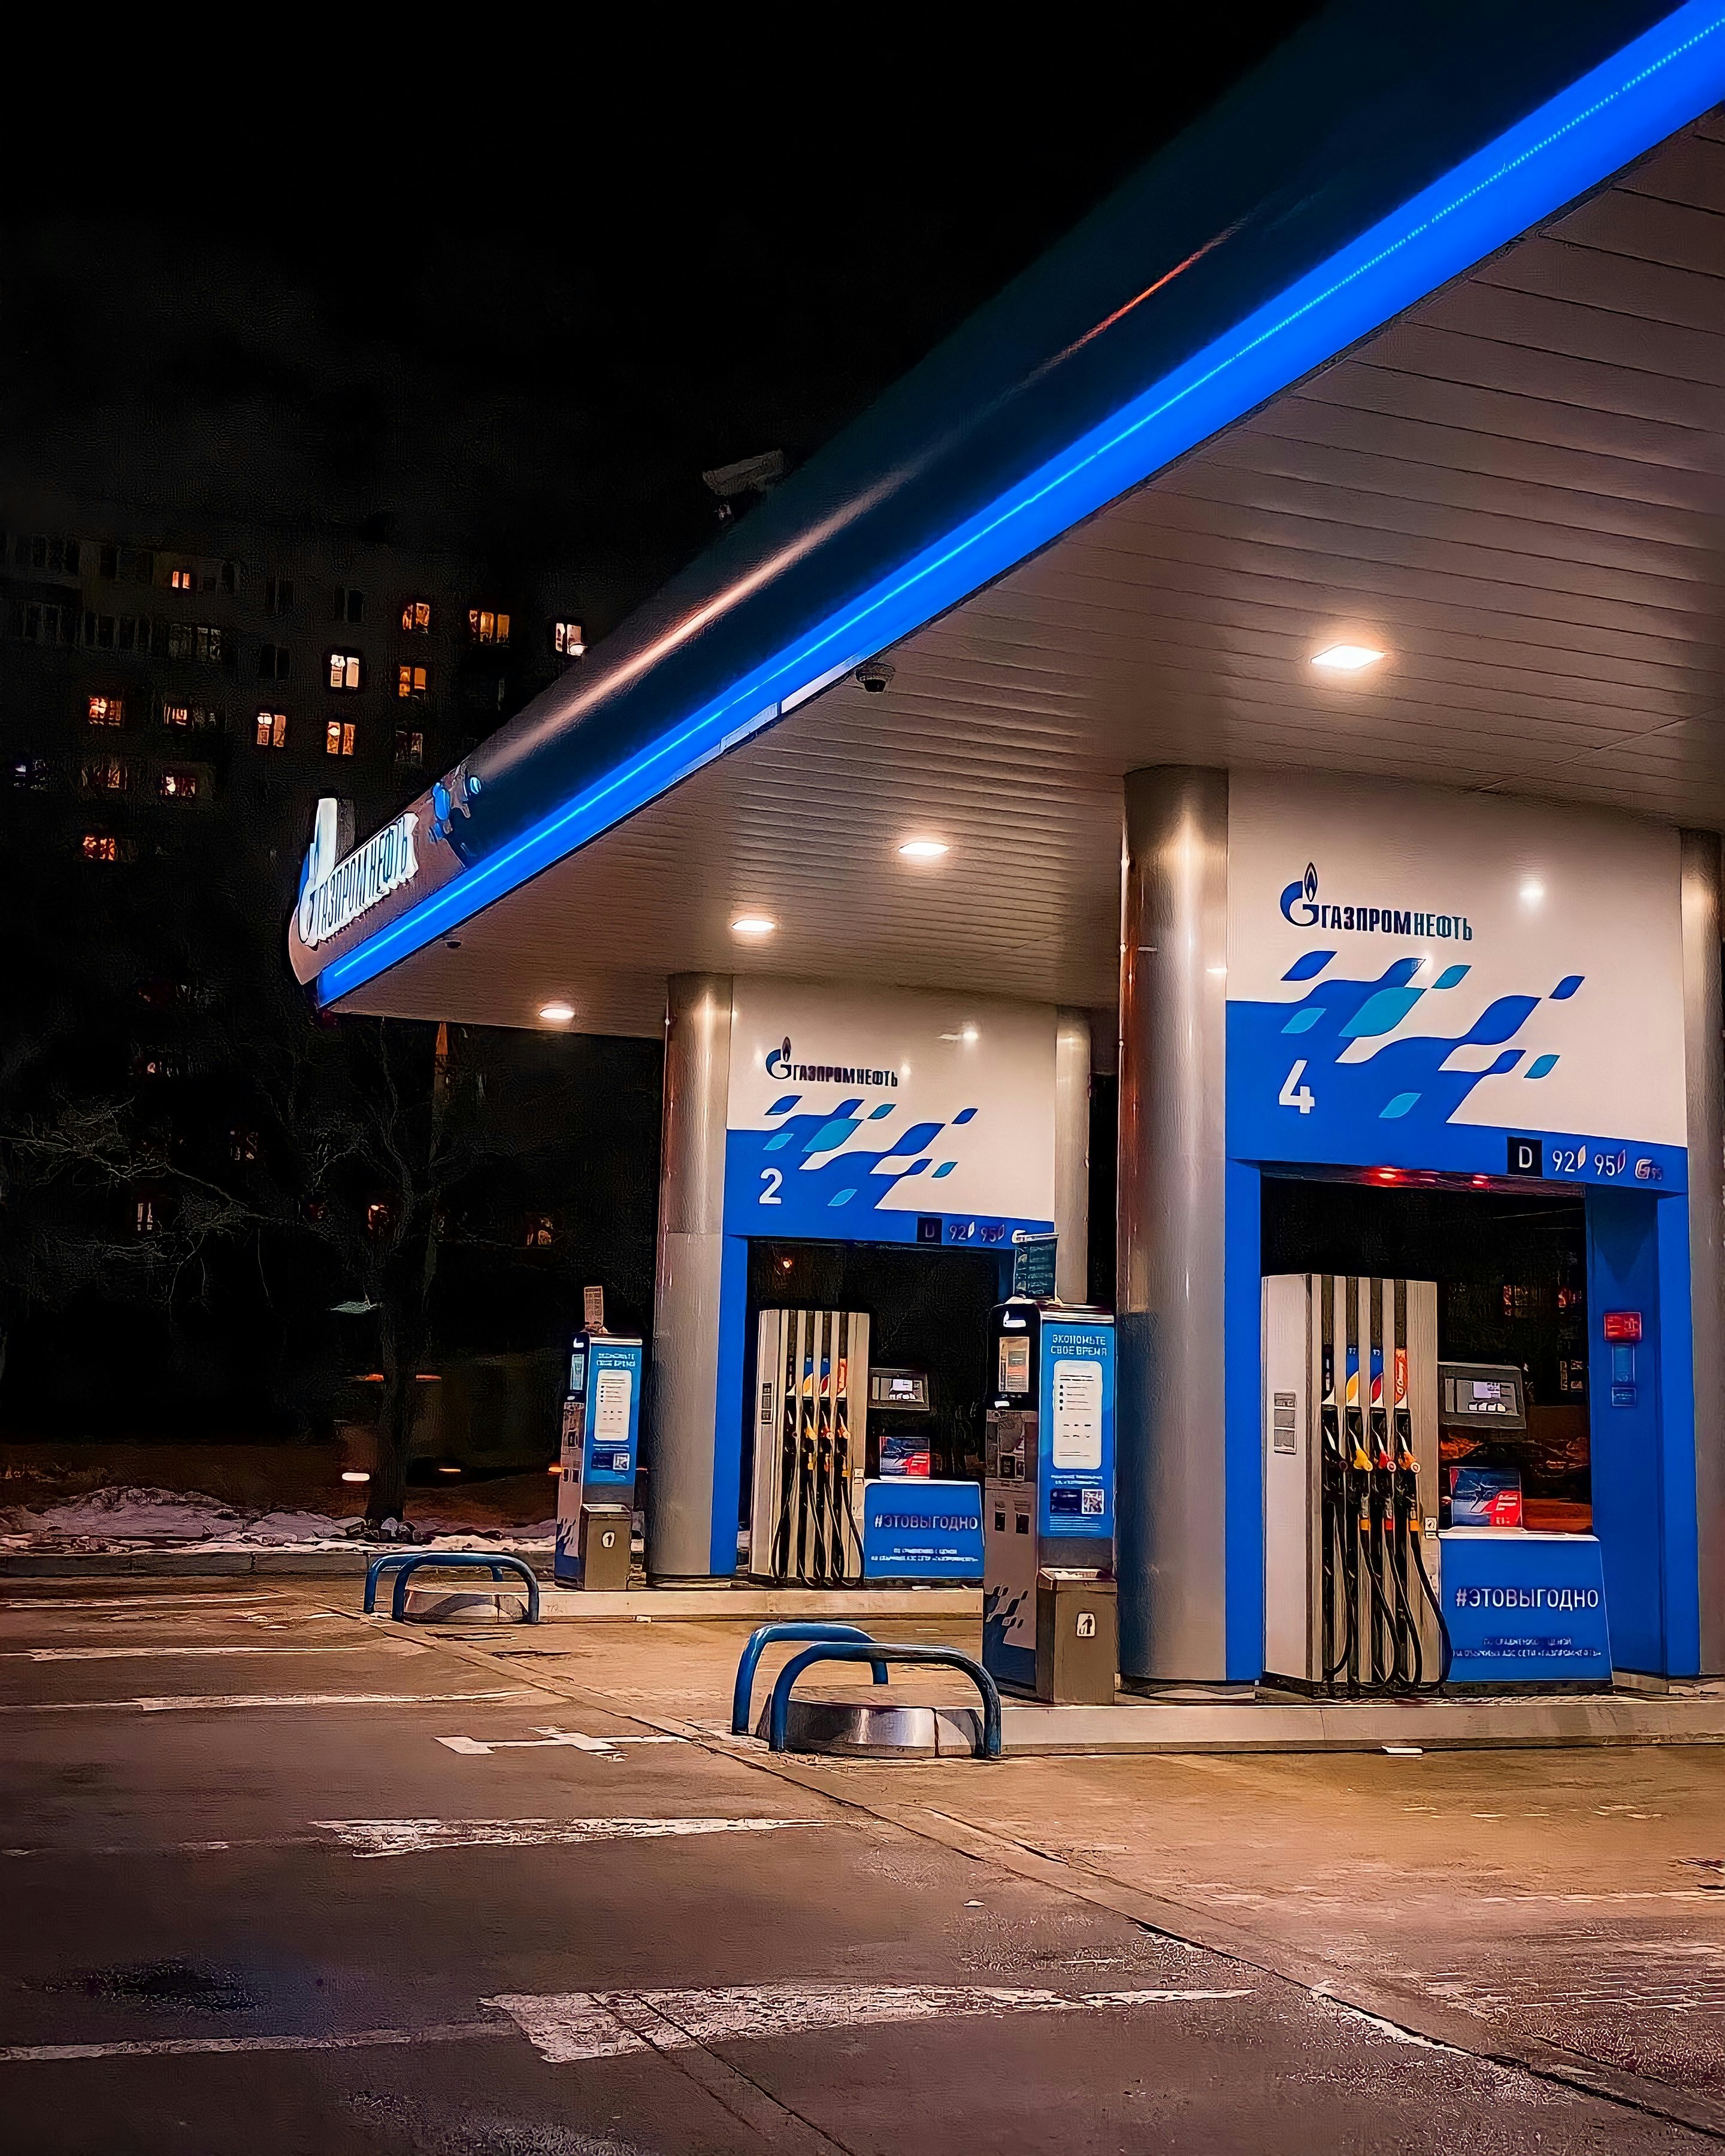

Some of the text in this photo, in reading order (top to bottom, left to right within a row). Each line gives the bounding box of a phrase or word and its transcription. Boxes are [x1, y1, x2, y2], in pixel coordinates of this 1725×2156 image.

[1321, 905, 1472, 941] ГАЗПРОМНЕФТЬ
[793, 1065, 898, 1087] ГАЗПРОМНЕФТЬ
[1279, 1059, 1315, 1114] 4
[1519, 1146, 1533, 1168] D
[1552, 1150, 1575, 1172] 92
[1594, 1154, 1615, 1176] 95
[759, 1168, 783, 1204] 2
[949, 1225, 967, 1240] 92
[980, 1227, 997, 1242] 95
[874, 1514, 979, 1531] #ЭТОВЫГОДНО
[1455, 1588, 1599, 1612] #ЭТОВЫГОДНО
